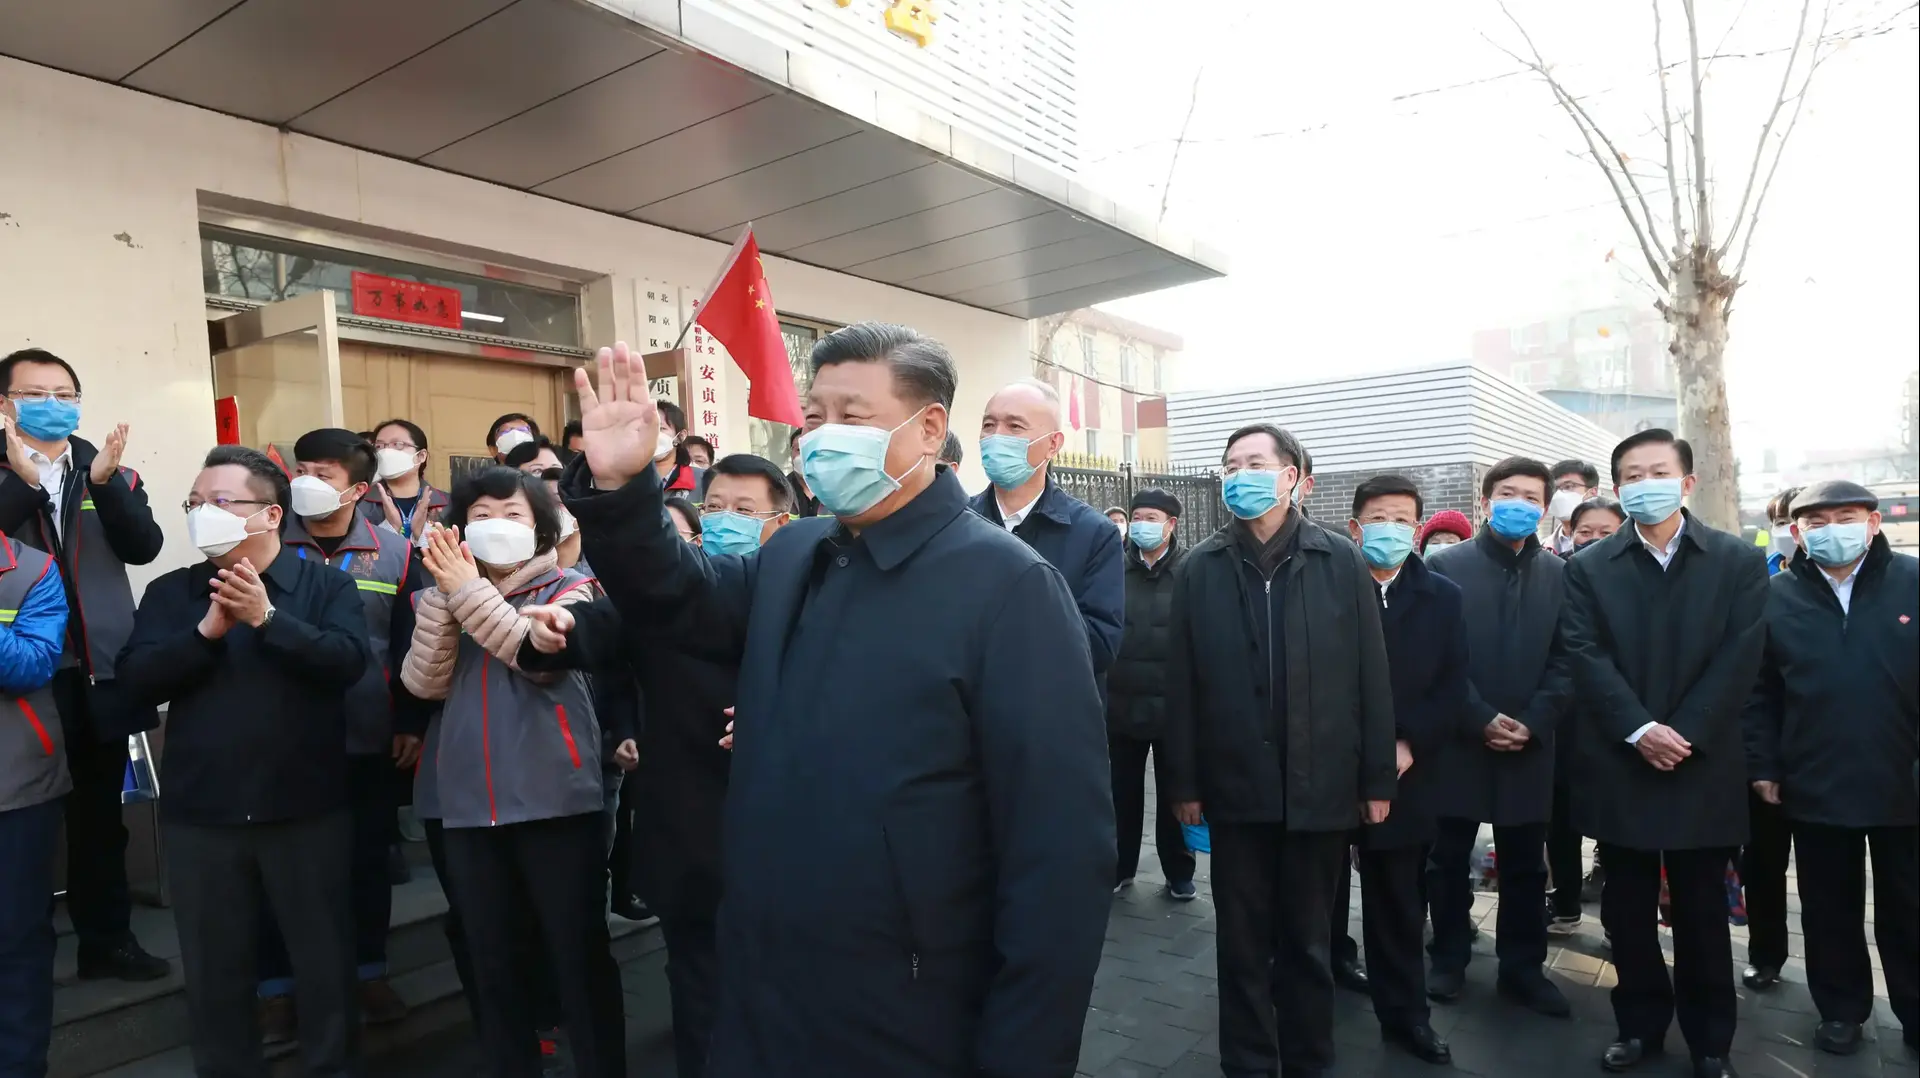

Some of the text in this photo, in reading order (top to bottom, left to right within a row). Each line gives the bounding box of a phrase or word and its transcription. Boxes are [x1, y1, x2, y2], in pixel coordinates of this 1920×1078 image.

[367, 289, 449, 319] 万事如意
[646, 291, 658, 347] 朝阳区
[660, 293, 671, 349] 北京市
[699, 364, 720, 449] 安贞街道
